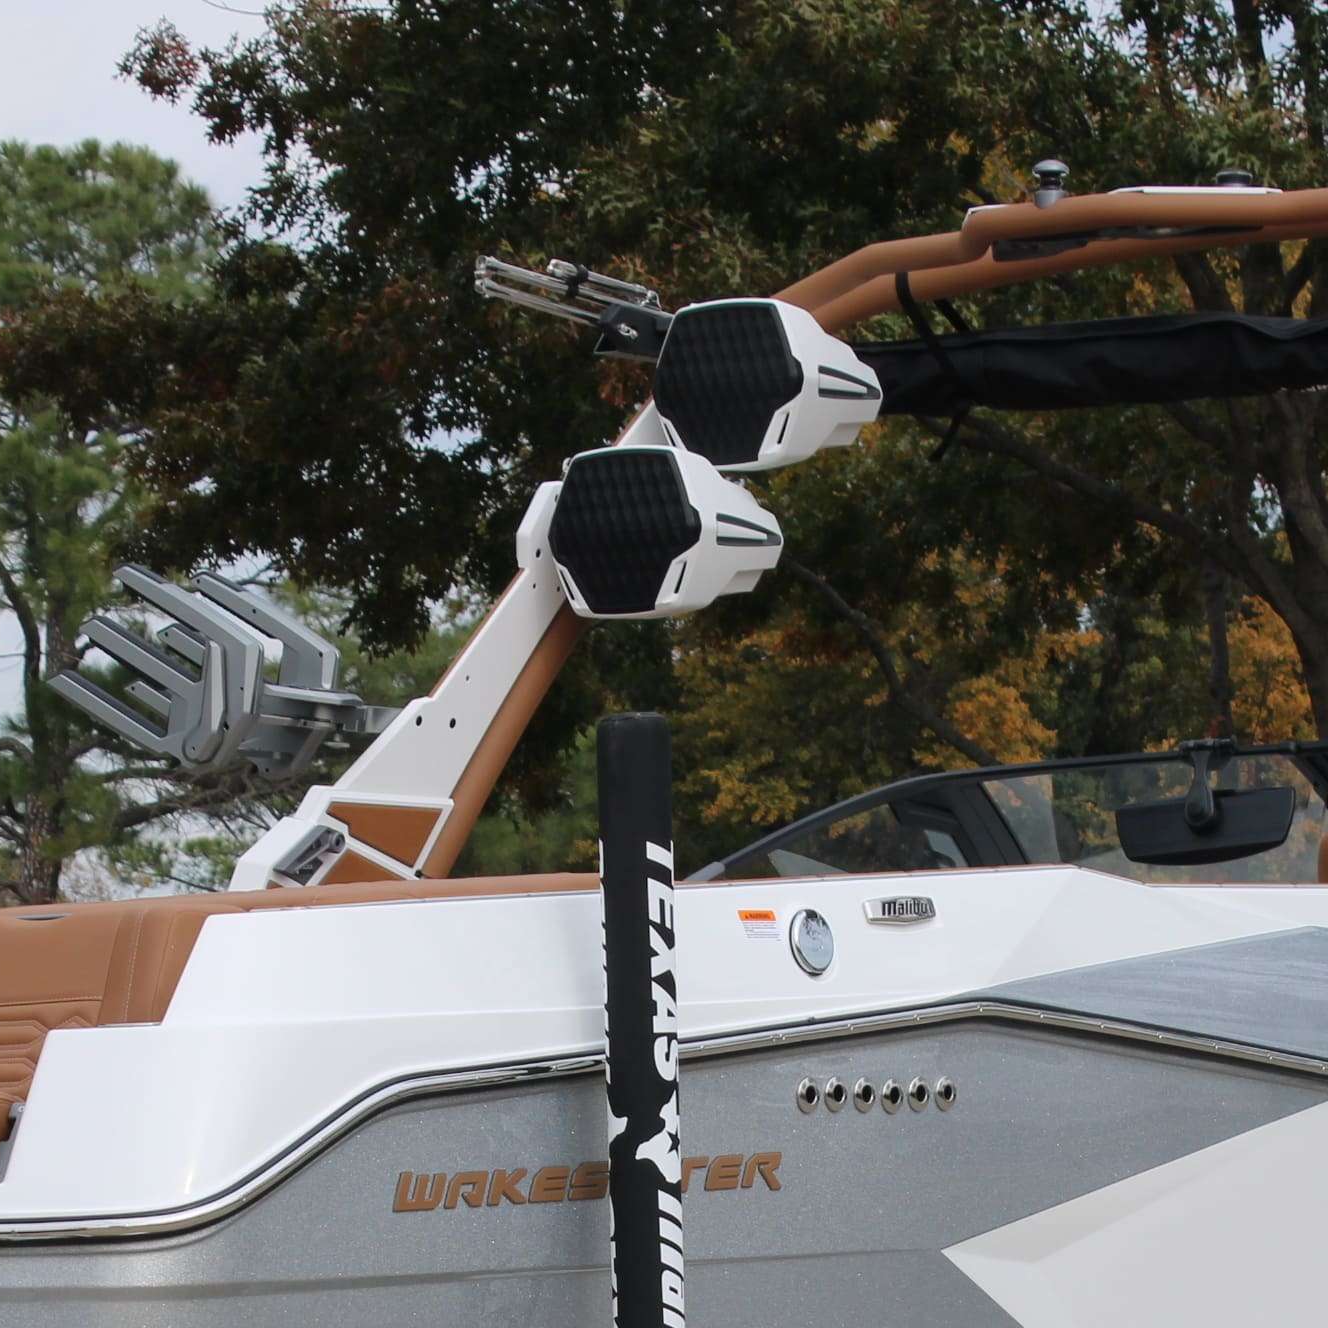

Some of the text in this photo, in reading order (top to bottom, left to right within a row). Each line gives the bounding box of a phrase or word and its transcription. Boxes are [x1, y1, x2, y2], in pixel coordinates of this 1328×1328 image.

[881, 899, 928, 917] Malibu
[645, 839, 681, 1083] TEXAS
[392, 1151, 783, 1213] WAKESTER
